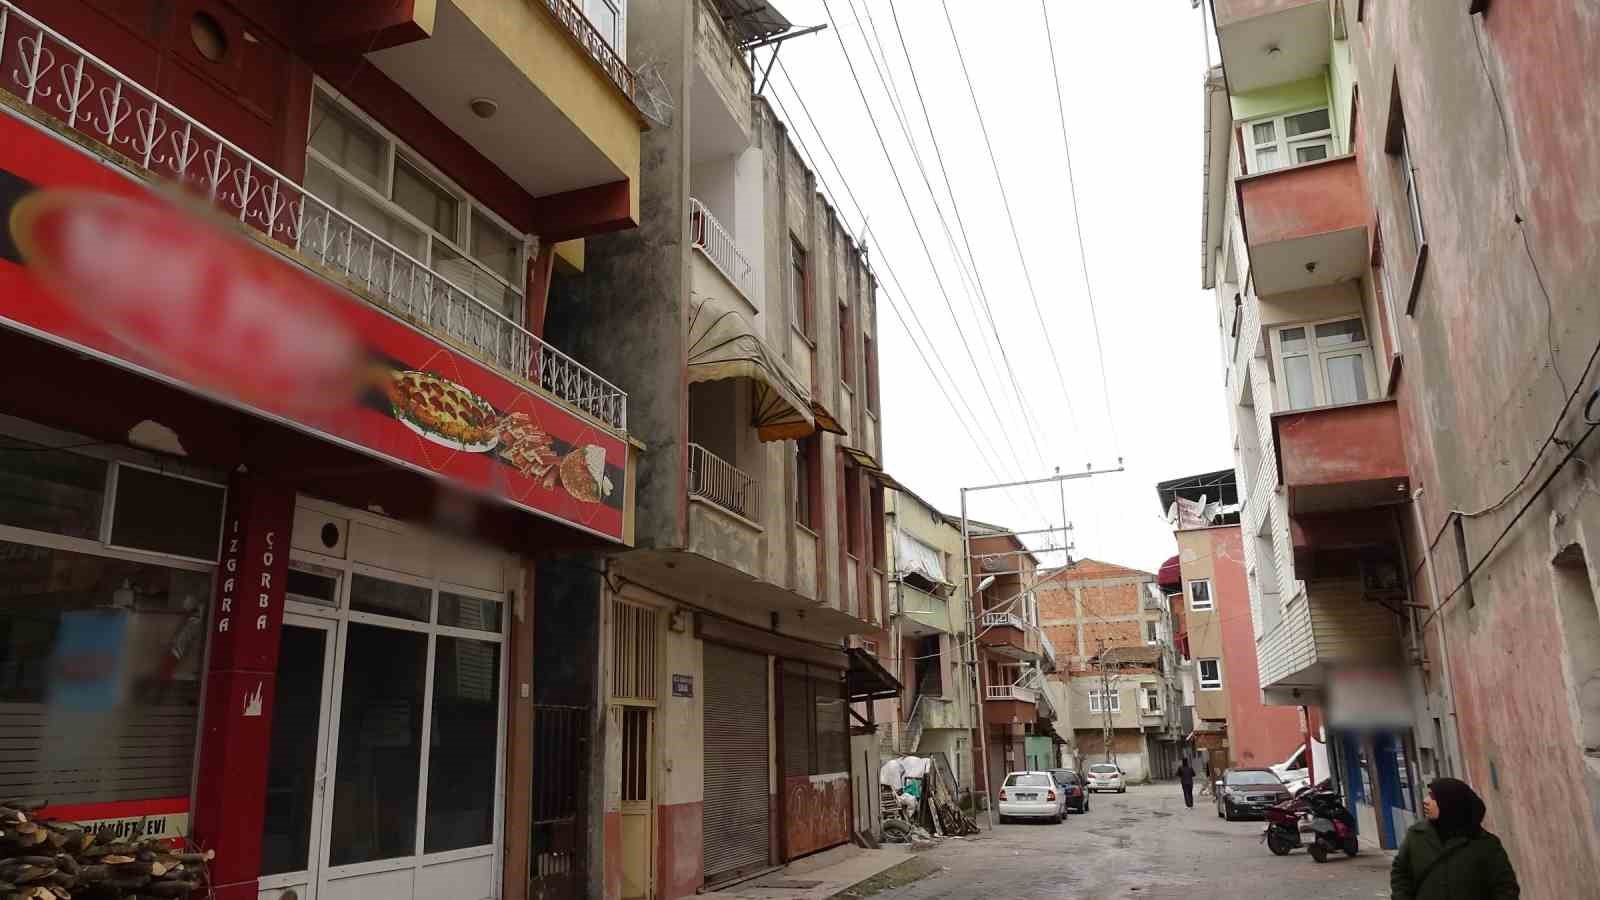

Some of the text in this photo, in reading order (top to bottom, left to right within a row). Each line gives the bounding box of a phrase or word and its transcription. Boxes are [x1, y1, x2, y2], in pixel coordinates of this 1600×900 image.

[219, 519, 239, 633] IZGARA
[256, 531, 275, 631] ÇORBA
[147, 816, 167, 835] EVİ
